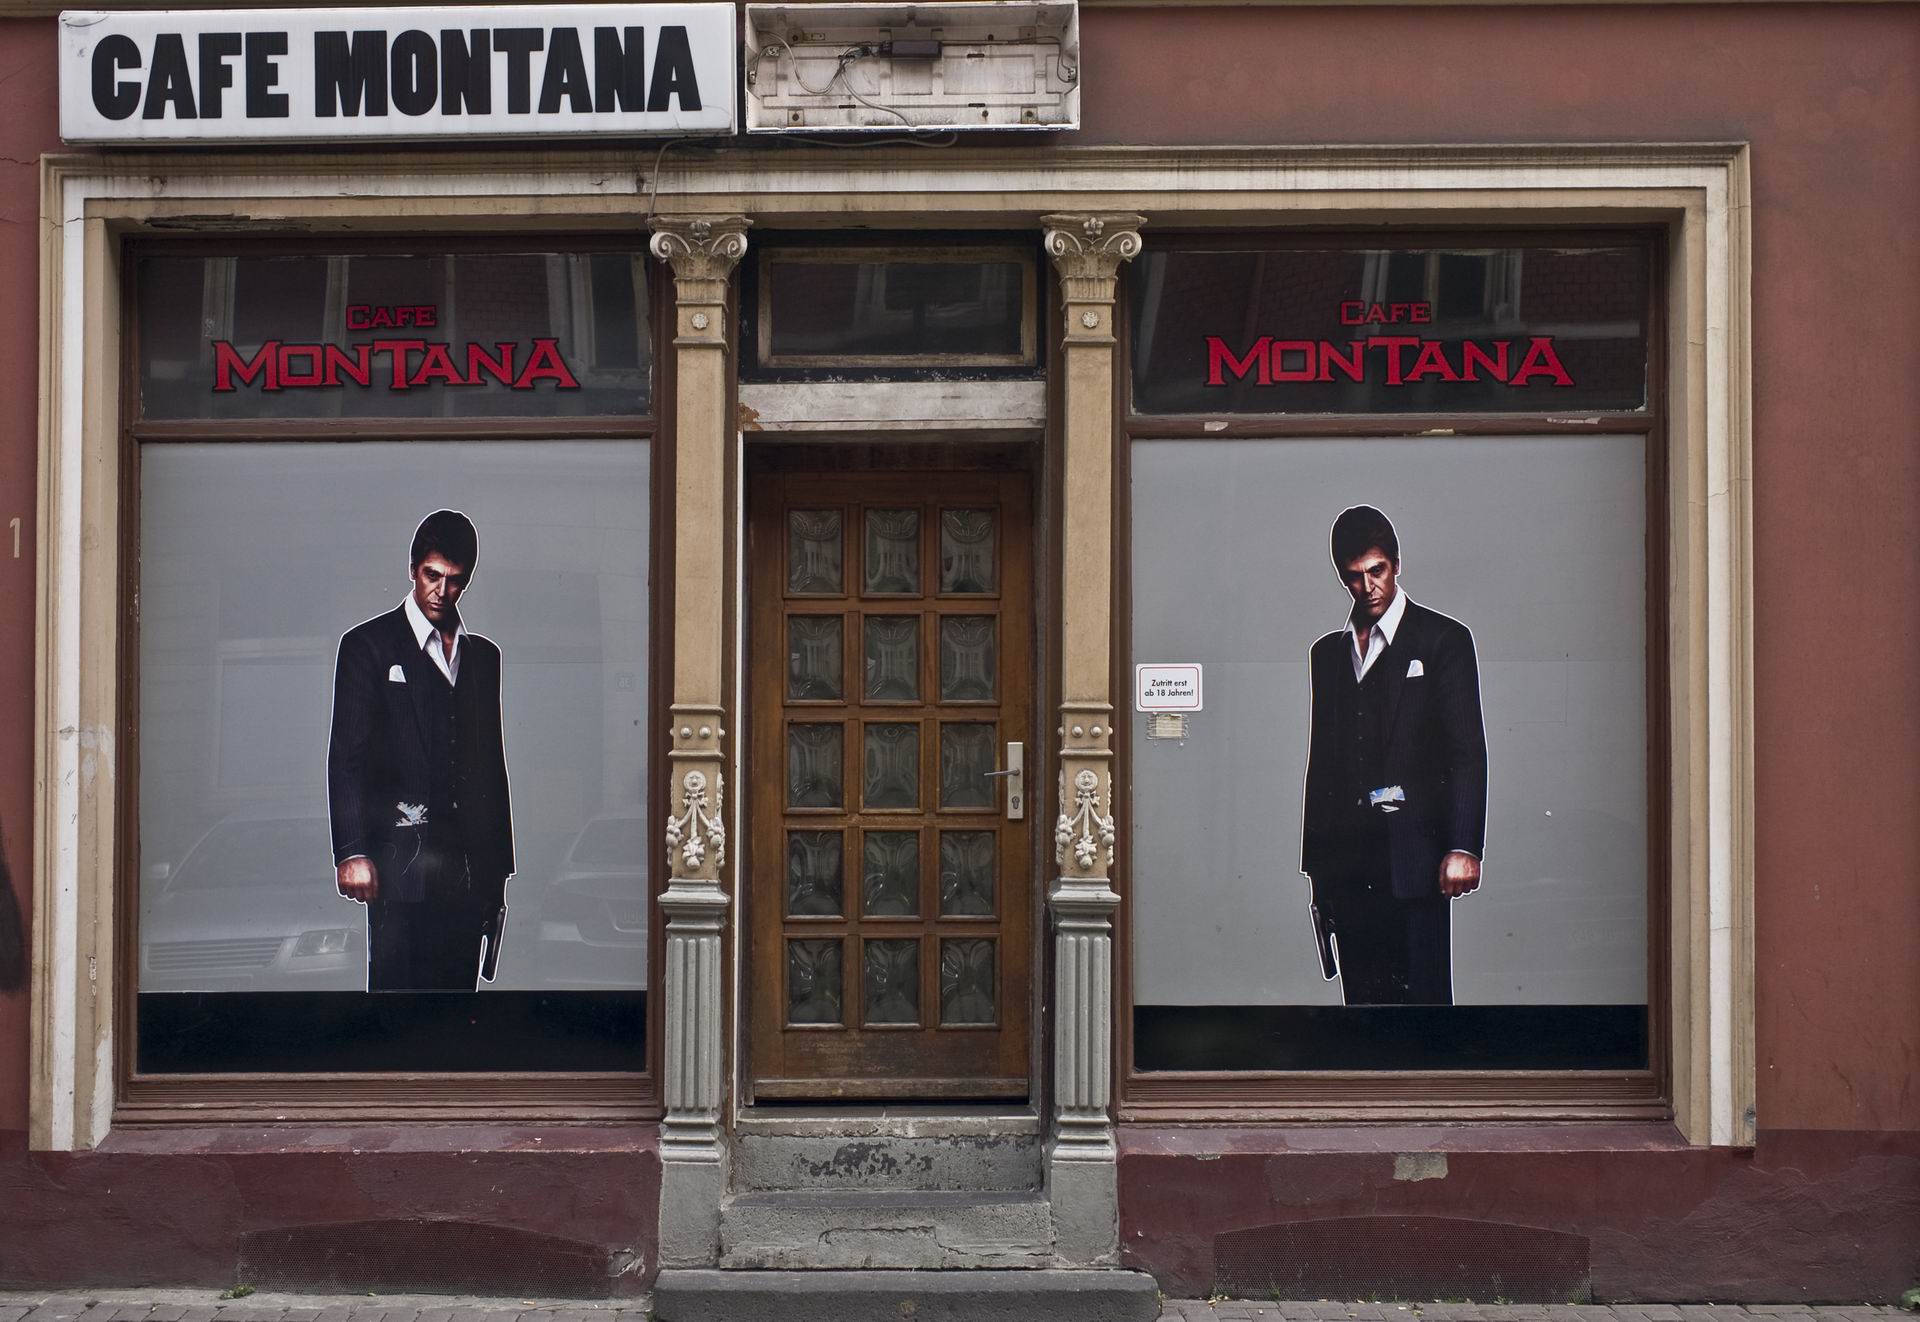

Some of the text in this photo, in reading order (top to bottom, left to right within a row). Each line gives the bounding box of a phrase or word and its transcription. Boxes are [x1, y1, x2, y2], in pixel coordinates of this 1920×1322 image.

[91, 26, 703, 120] CAFE MONTANA
[345, 305, 437, 330] CAFE
[1340, 300, 1432, 326] CAFE
[212, 337, 582, 392] MONTANA
[1204, 335, 1576, 387] MONTANA
[10, 517, 20, 558] 1
[1145, 689, 1194, 697] ab 18 Jahren!
[1152, 679, 1187, 687] Zutritt erst
